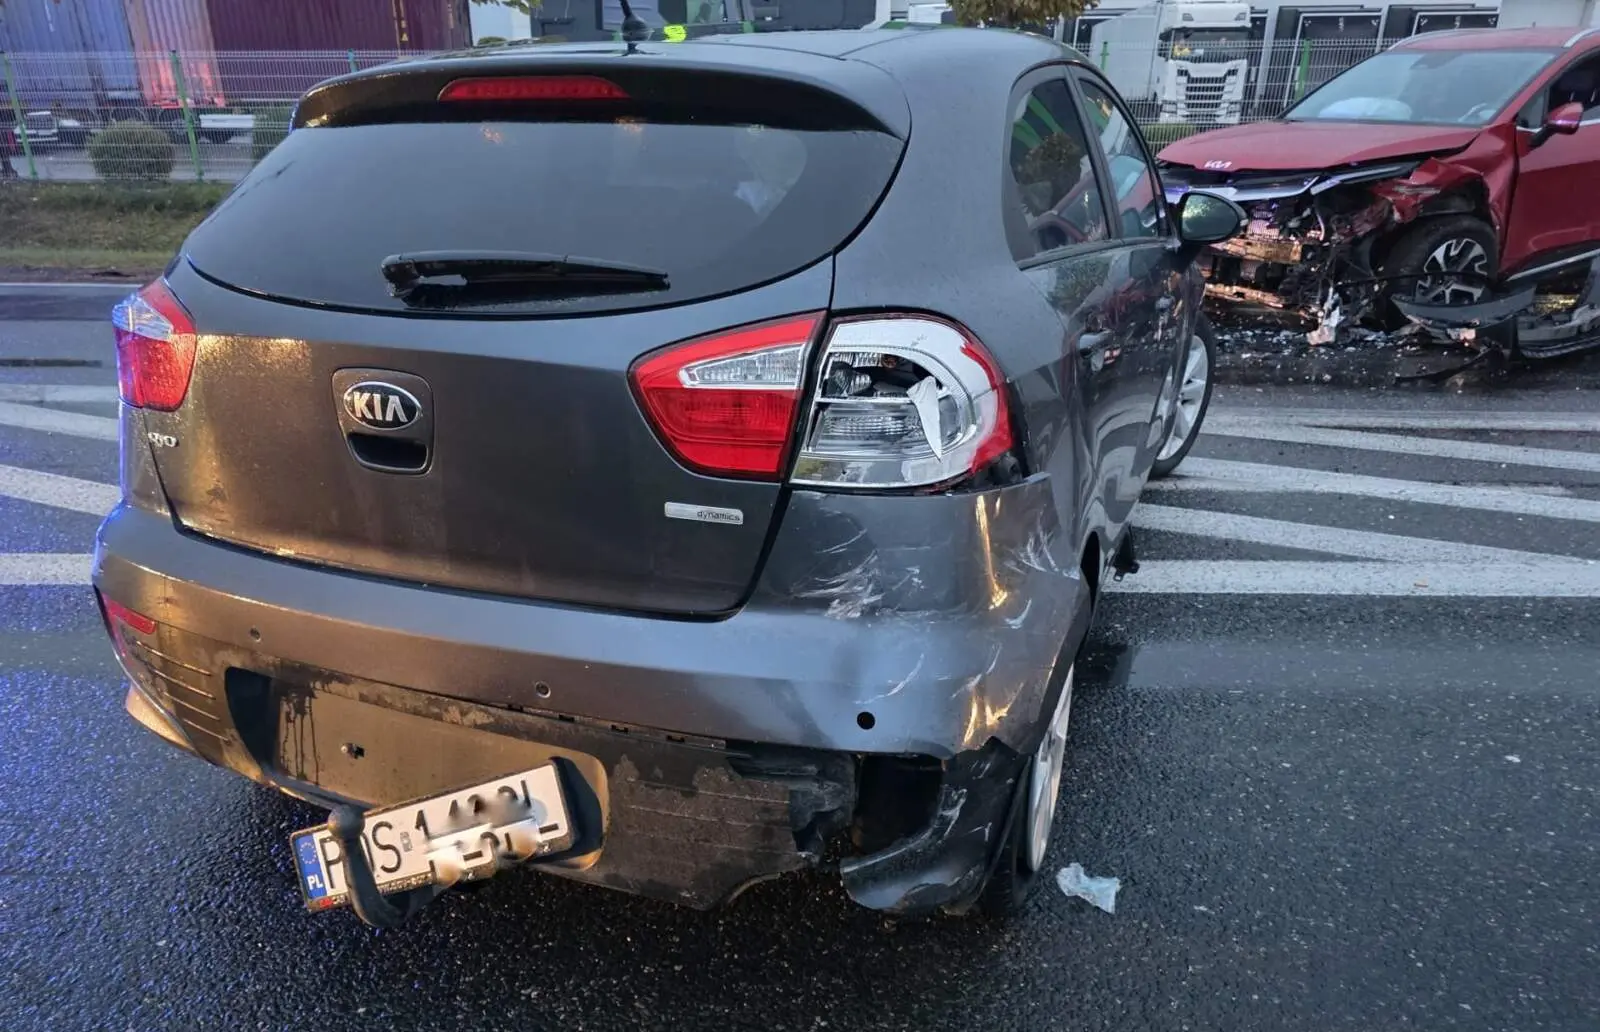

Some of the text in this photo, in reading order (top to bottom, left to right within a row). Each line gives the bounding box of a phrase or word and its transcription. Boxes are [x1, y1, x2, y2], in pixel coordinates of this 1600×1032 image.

[353, 391, 408, 422] KIA
[696, 510, 741, 521] dynamics
[307, 874, 324, 890] PL
